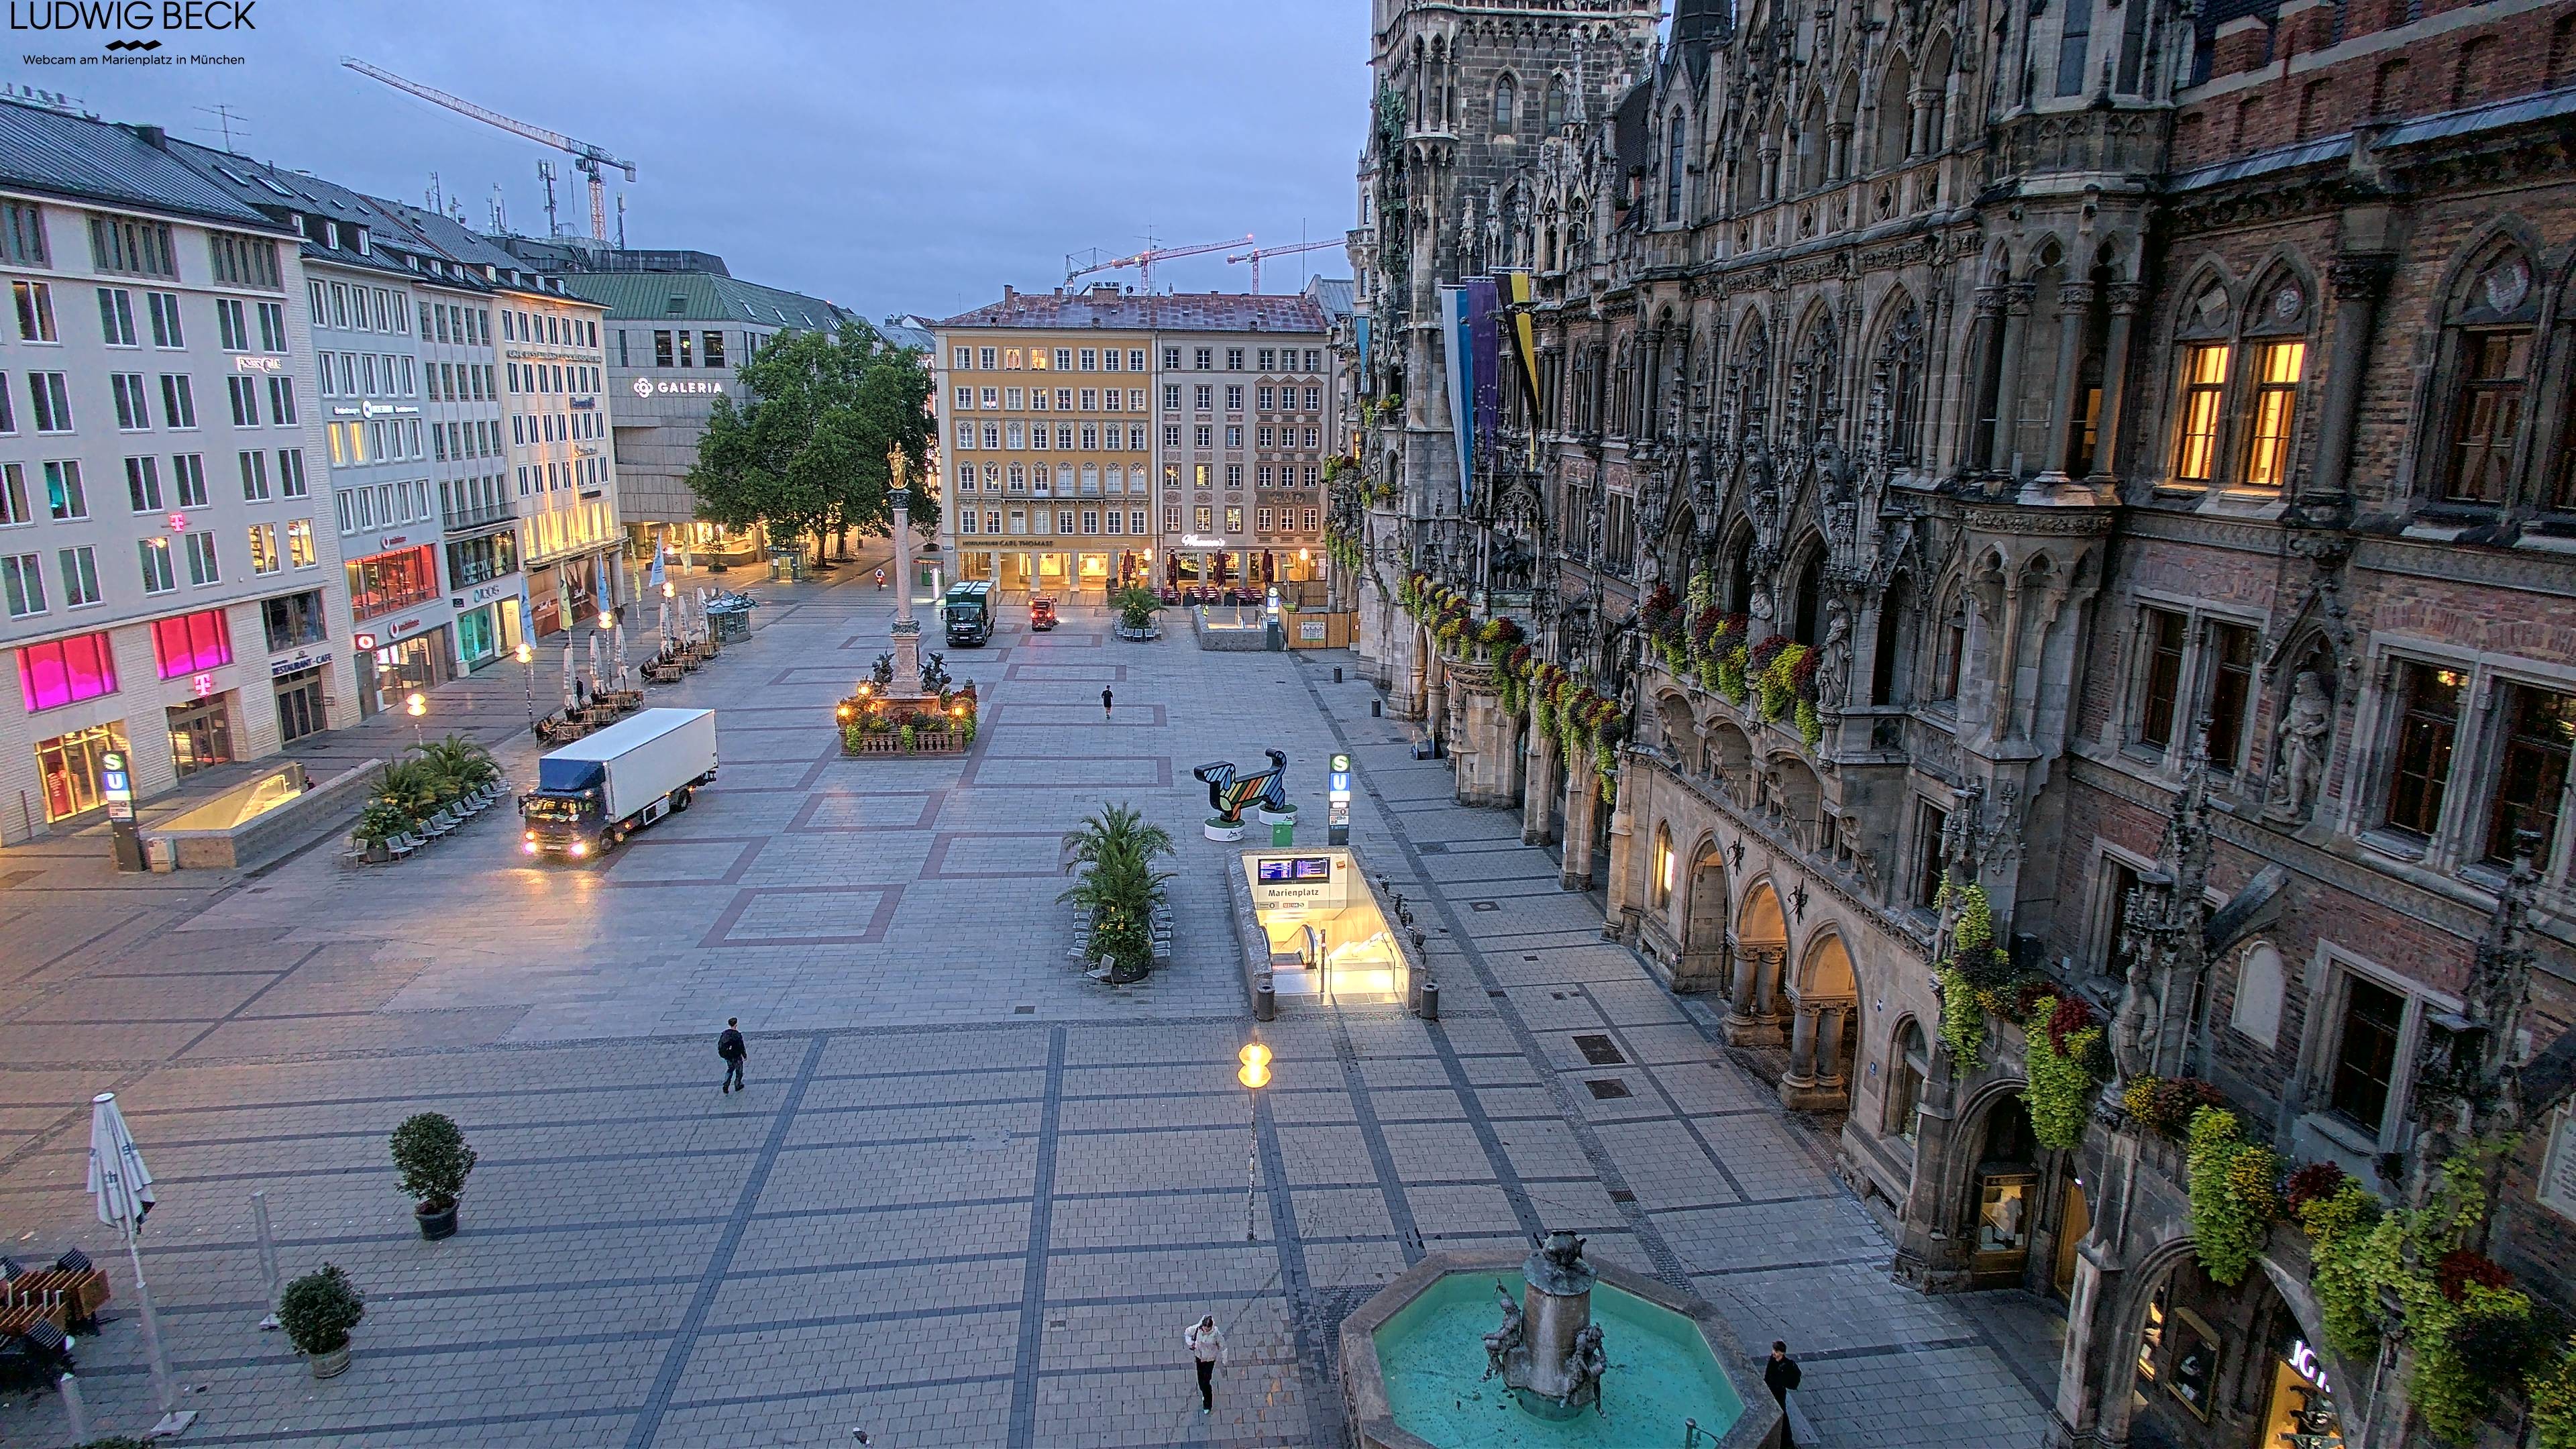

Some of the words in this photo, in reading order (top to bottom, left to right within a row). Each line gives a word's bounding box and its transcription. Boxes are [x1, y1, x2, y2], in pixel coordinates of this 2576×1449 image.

[657, 382, 723, 394] GALERIA
[1269, 587, 1278, 597] S
[1269, 598, 1277, 607] U
[103, 753, 121, 771] S
[1334, 755, 1348, 771] S
[107, 773, 123, 790] U
[1333, 774, 1346, 790] U
[1268, 888, 1320, 898] Marienplatz
